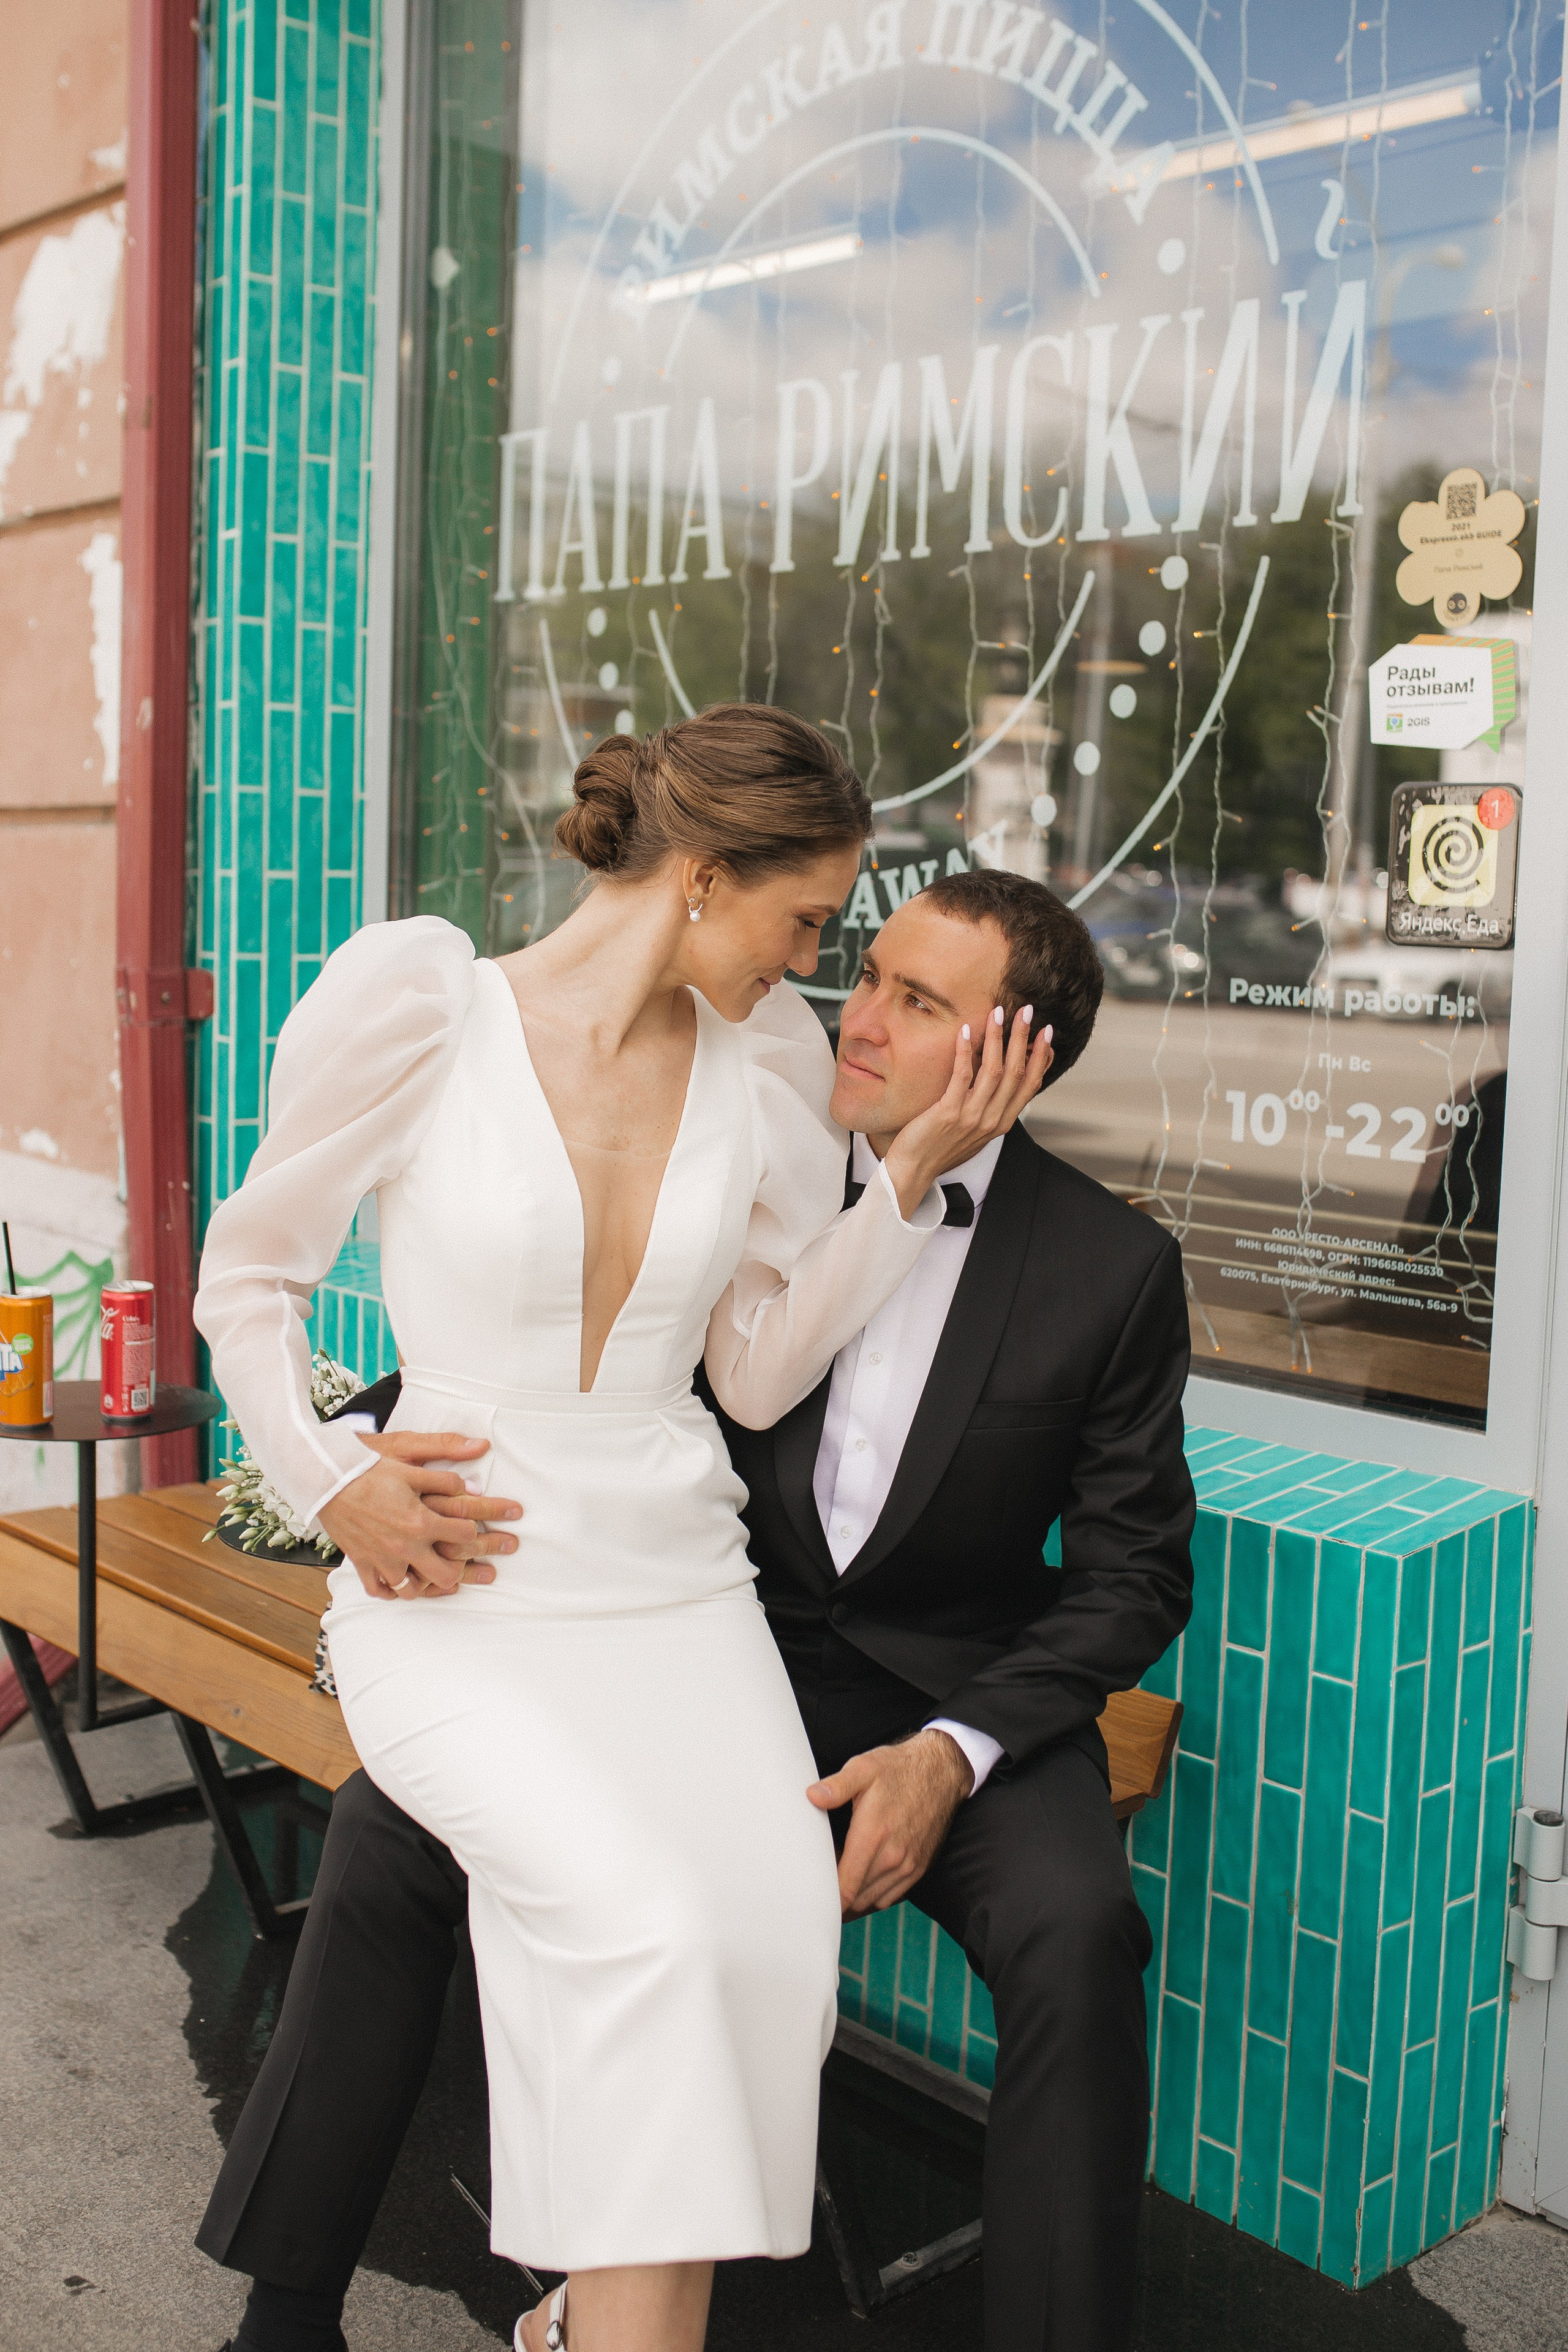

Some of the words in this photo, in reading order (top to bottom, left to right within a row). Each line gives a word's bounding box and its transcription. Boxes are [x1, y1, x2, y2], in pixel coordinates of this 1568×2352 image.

[919, 0, 1177, 226] ПИЦЦА
[494, 397, 732, 601] ПАПА
[770, 179, 1366, 573] РИМСКИЙ
[1388, 666, 1436, 681] Рады
[1387, 677, 1474, 697] отзывам!
[1408, 717, 1430, 726] 2GIS
[1491, 799, 1499, 818] 1
[1400, 911, 1499, 937] Яндекс.Еда
[1229, 978, 1334, 1008] Режим
[1344, 987, 1475, 1017] работы:
[1318, 1053, 1342, 1069] Пн
[1349, 1055, 1371, 1072] Вс
[1272, 1227, 1296, 1239] ООО
[1341, 1287, 1357, 1298] ул.
[1359, 1288, 1424, 1310] Малышева,
